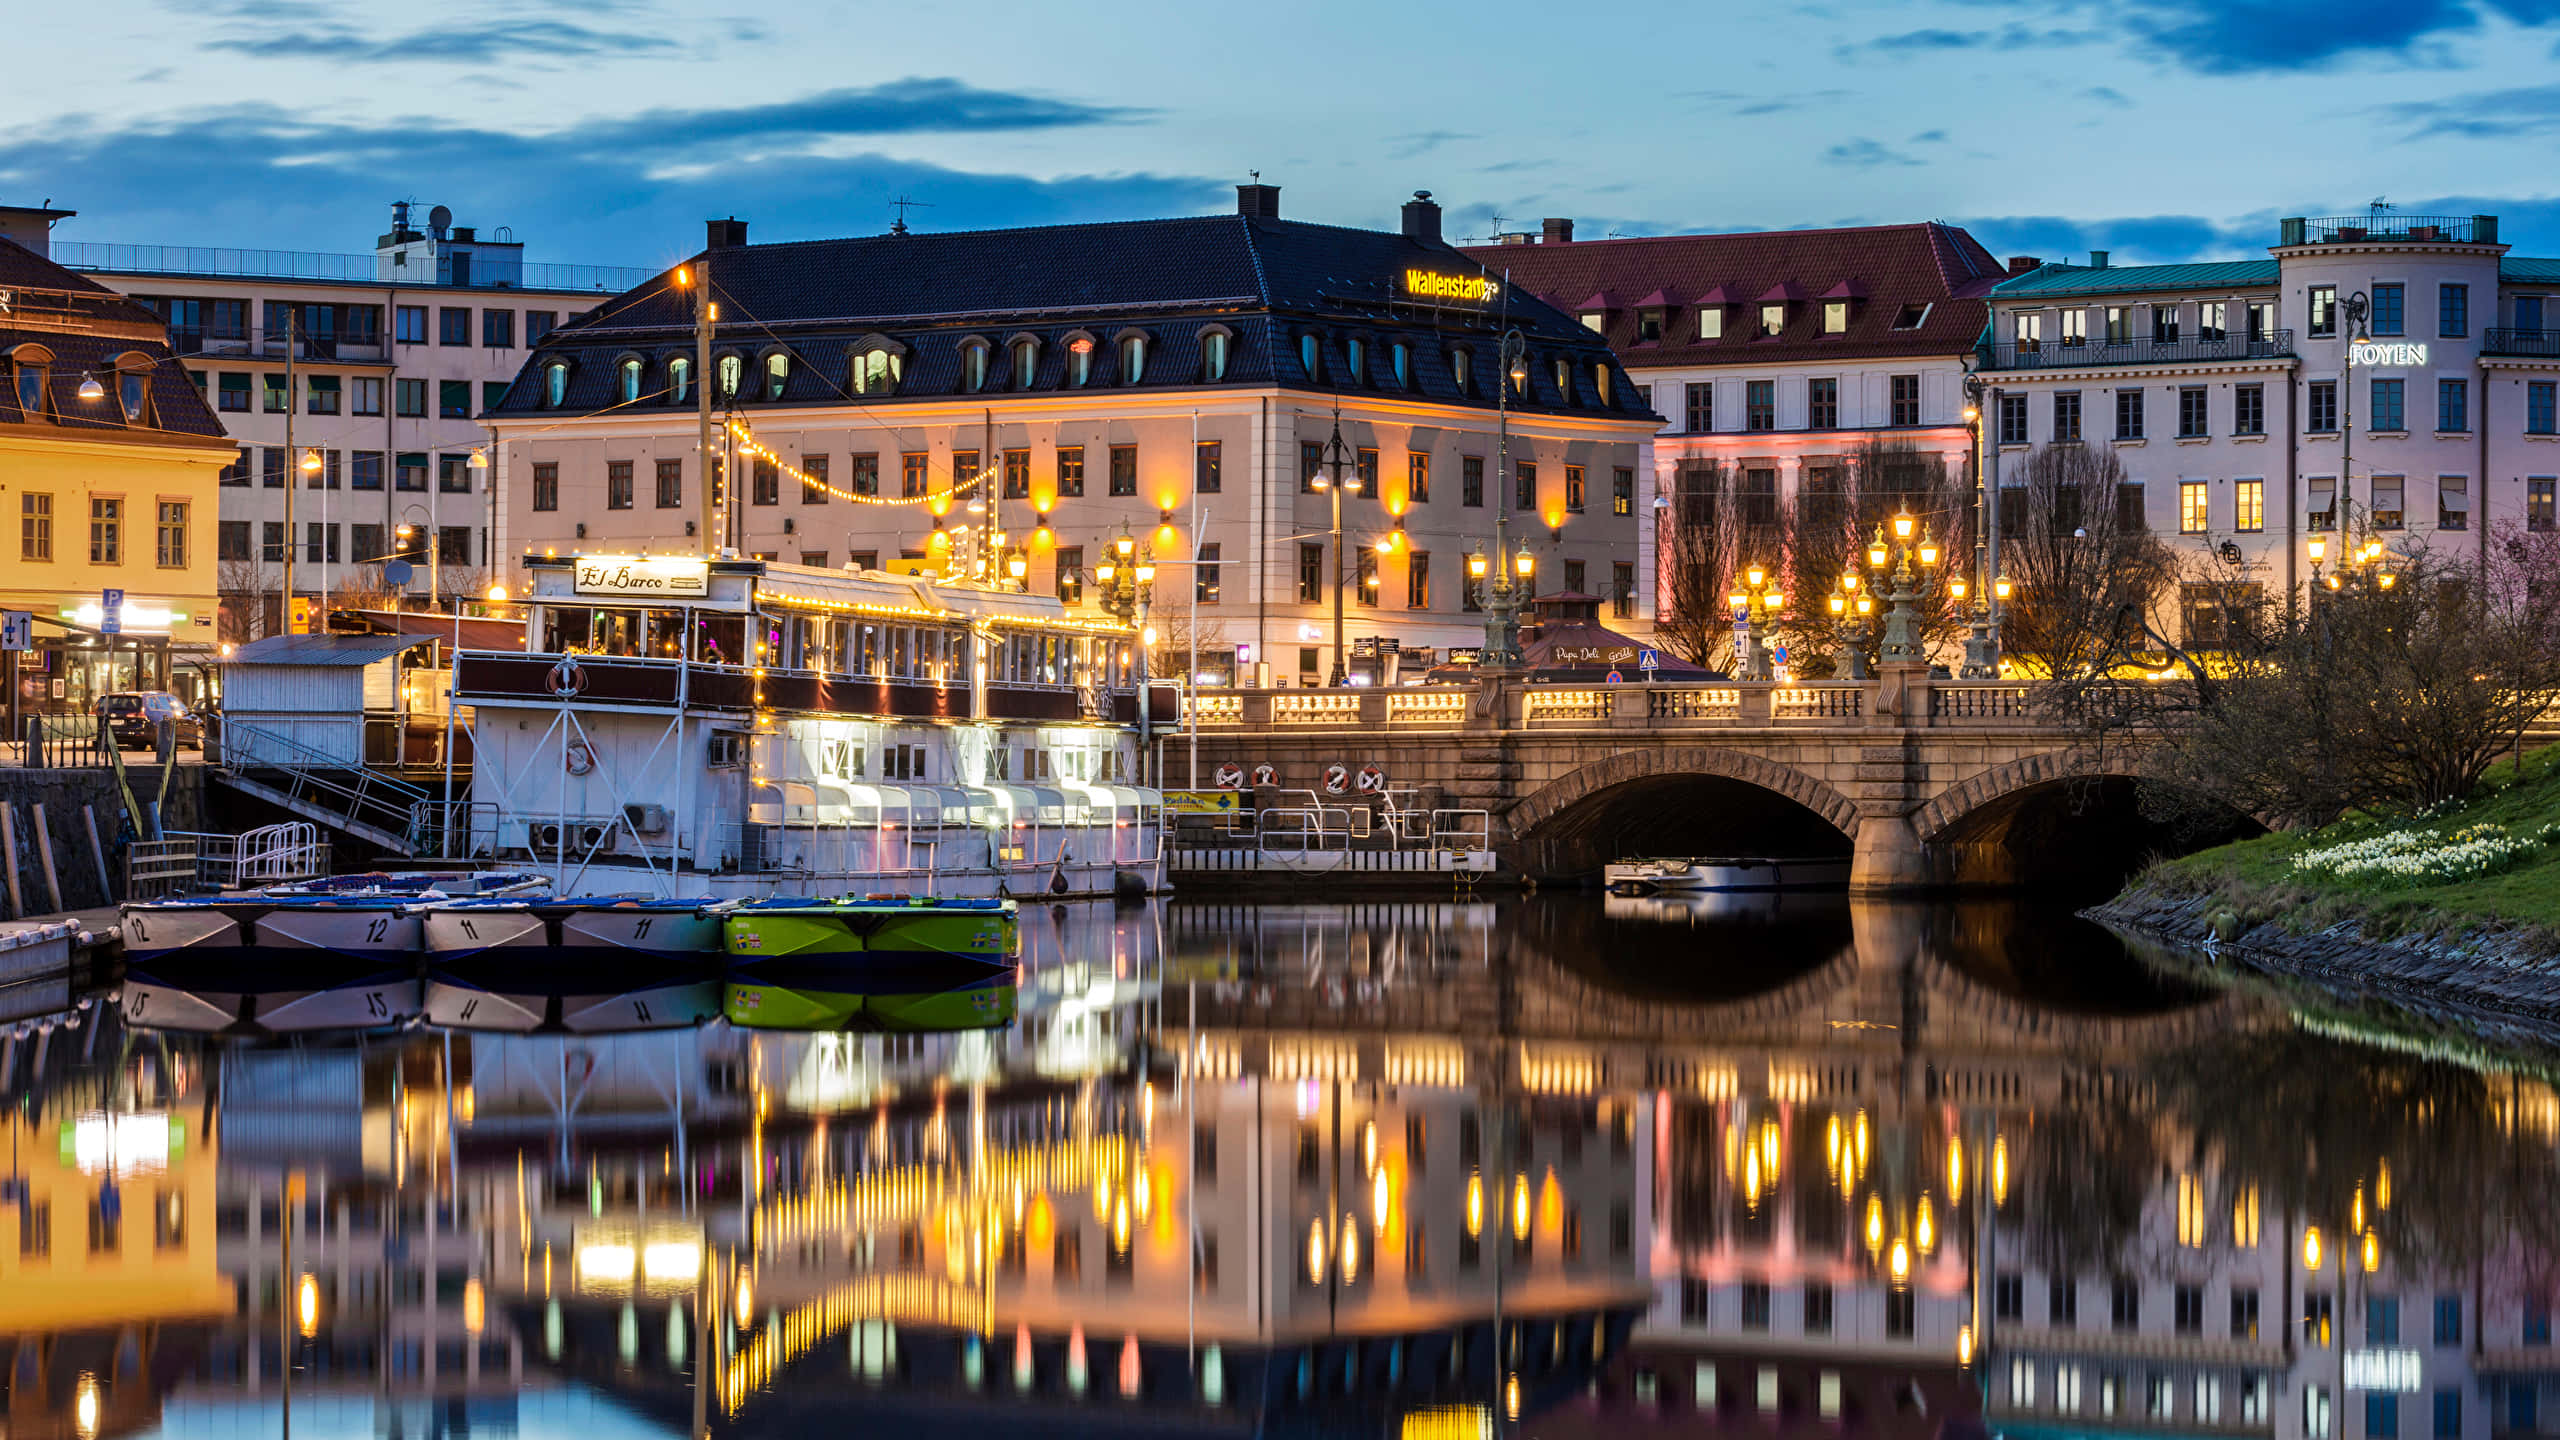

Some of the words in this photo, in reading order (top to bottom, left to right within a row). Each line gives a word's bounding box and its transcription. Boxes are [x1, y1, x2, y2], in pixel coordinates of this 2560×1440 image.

[1407, 269, 1485, 299] Wallenstam
[2350, 343, 2427, 366] FOYEN
[580, 565, 609, 586] El
[608, 566, 663, 588] Barco
[109, 591, 120, 606] P
[1580, 647, 1600, 661] Deli
[1608, 647, 1634, 661] Grill
[131, 918, 151, 943] 12
[366, 918, 388, 943] 12
[460, 919, 479, 940] 11
[633, 918, 653, 940] 11
